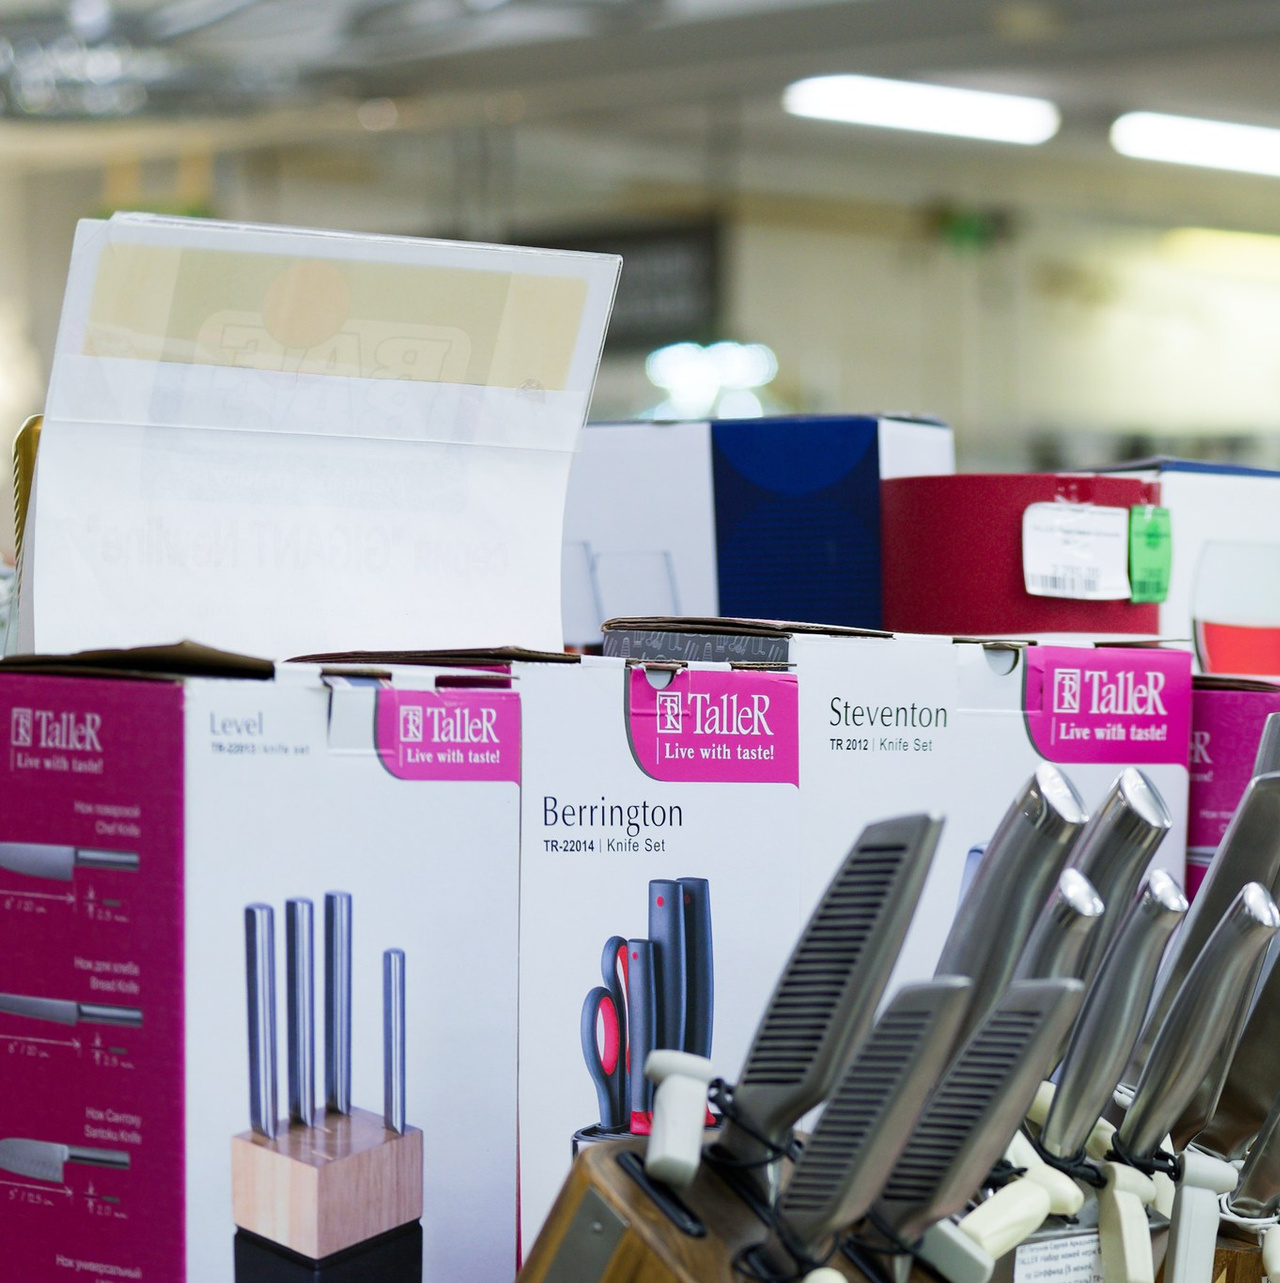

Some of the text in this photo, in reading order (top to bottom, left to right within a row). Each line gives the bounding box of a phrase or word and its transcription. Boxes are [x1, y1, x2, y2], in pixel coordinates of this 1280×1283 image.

[1084, 670, 1167, 716] TalleR
[210, 711, 264, 736] Level
[687, 693, 774, 736] TalleR
[829, 696, 948, 728] Steventon
[35, 709, 103, 752] TalleR
[427, 707, 500, 743] TalleR
[1060, 723, 1167, 742] Live with taste!
[407, 748, 500, 764] Live with taste!
[665, 743, 775, 760] Live with taste!
[830, 737, 932, 752] TR 2012 Knife Set
[17, 753, 40, 770] Live
[44, 755, 69, 771] with
[543, 796, 683, 838] Berrington
[544, 838, 666, 852] TR-22014 Knife Set
